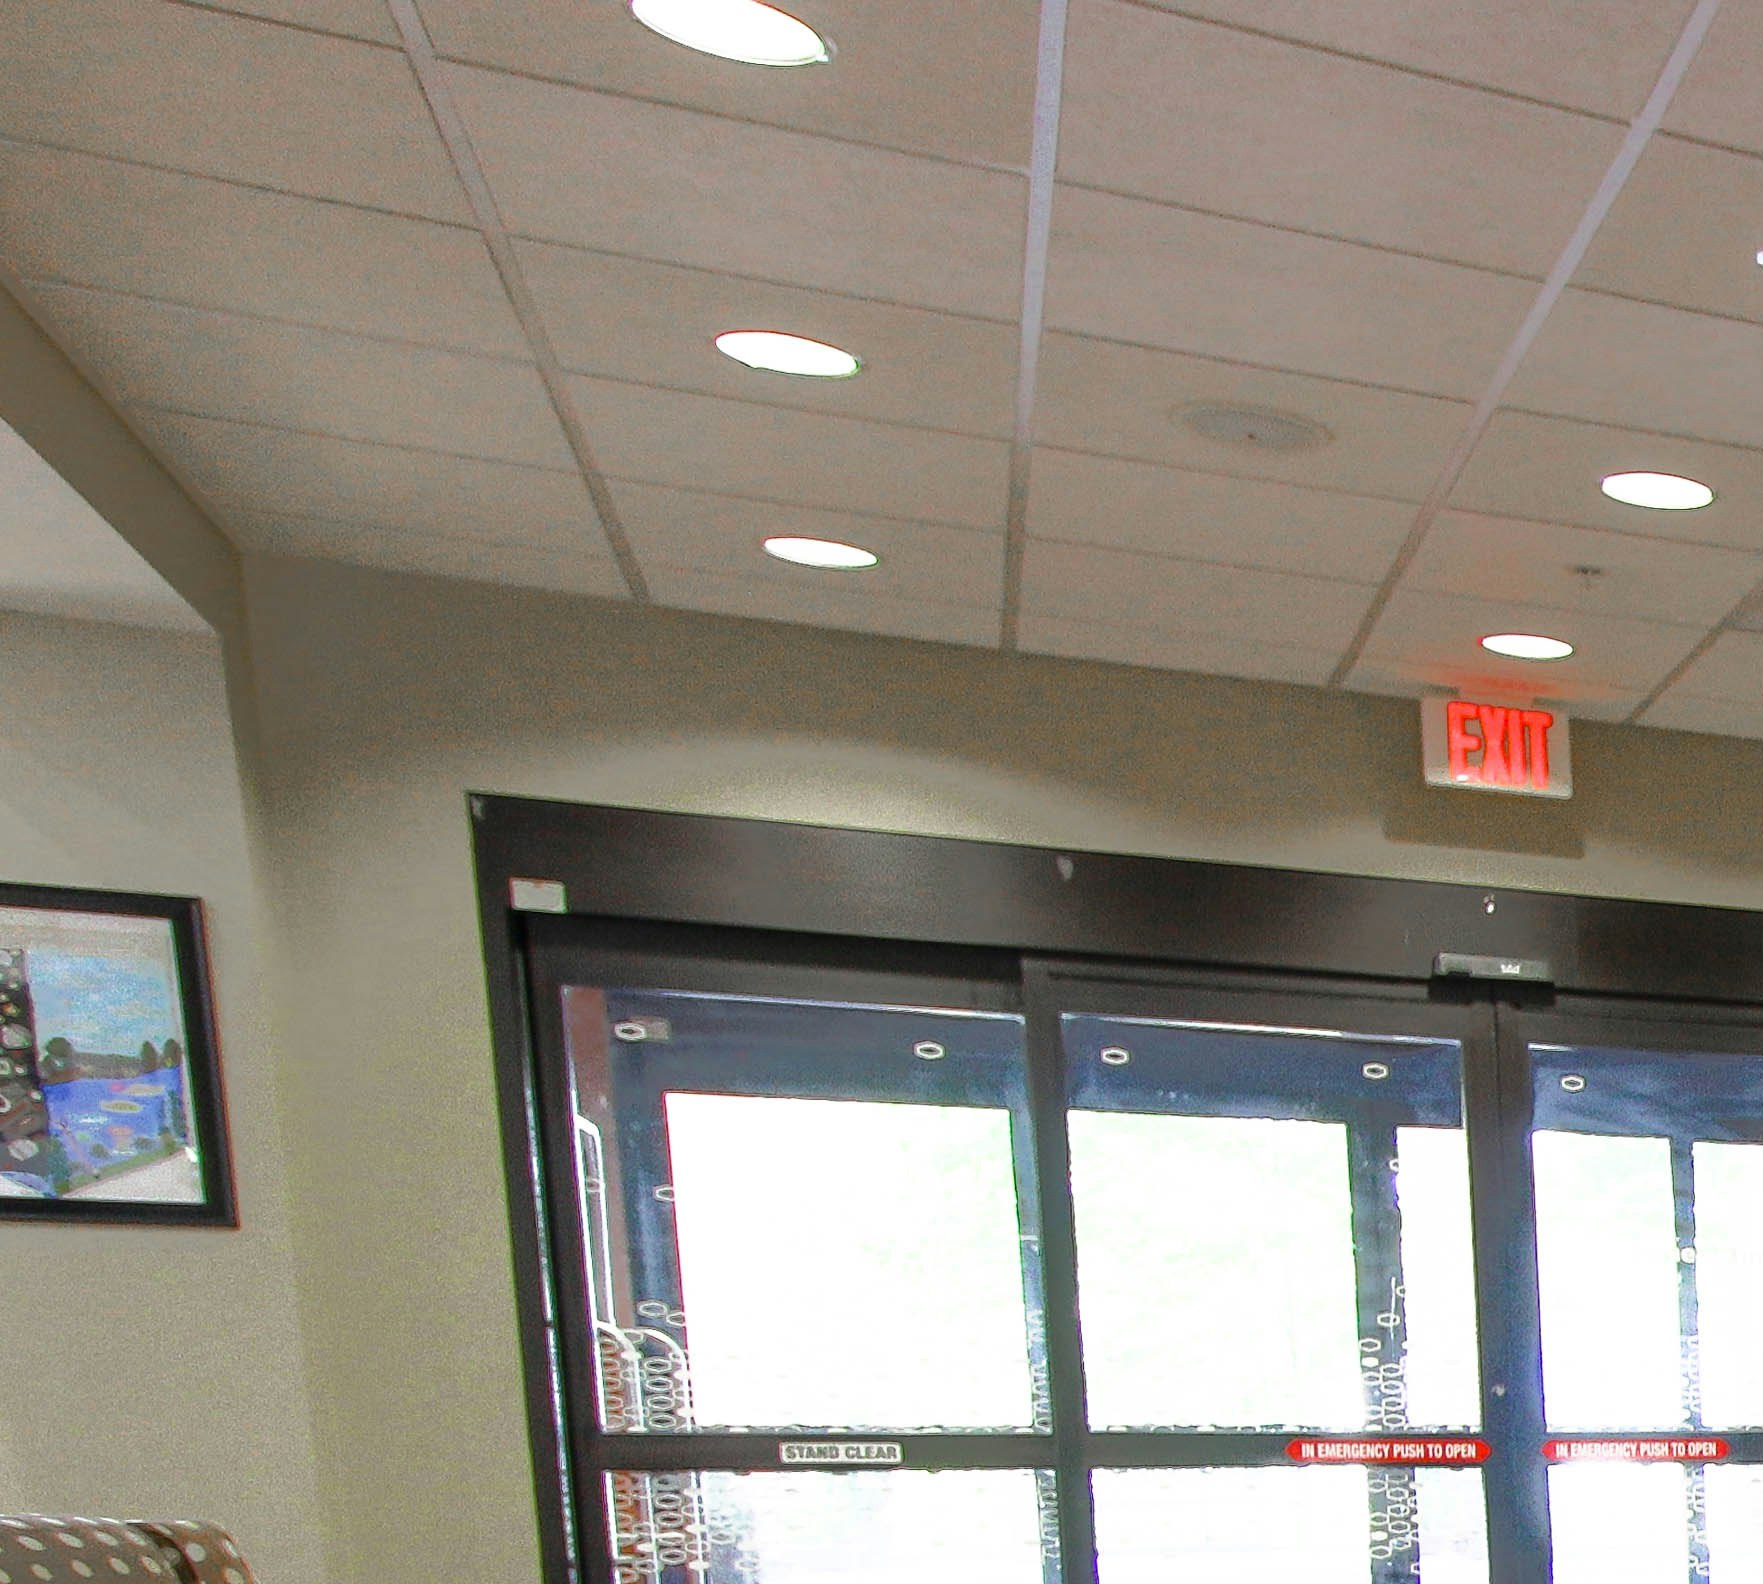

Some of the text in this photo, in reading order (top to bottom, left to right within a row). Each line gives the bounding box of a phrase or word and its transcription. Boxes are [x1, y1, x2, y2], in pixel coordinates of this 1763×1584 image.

[1447, 701, 1553, 788] EXIT
[785, 1445, 897, 1459] STAND CLEAR
[1302, 1442, 1476, 1459] IN EMERGENCY PUSH TO OPEN
[1555, 1441, 1717, 1458] IN EMERGENCY PUSH TO OPEN
